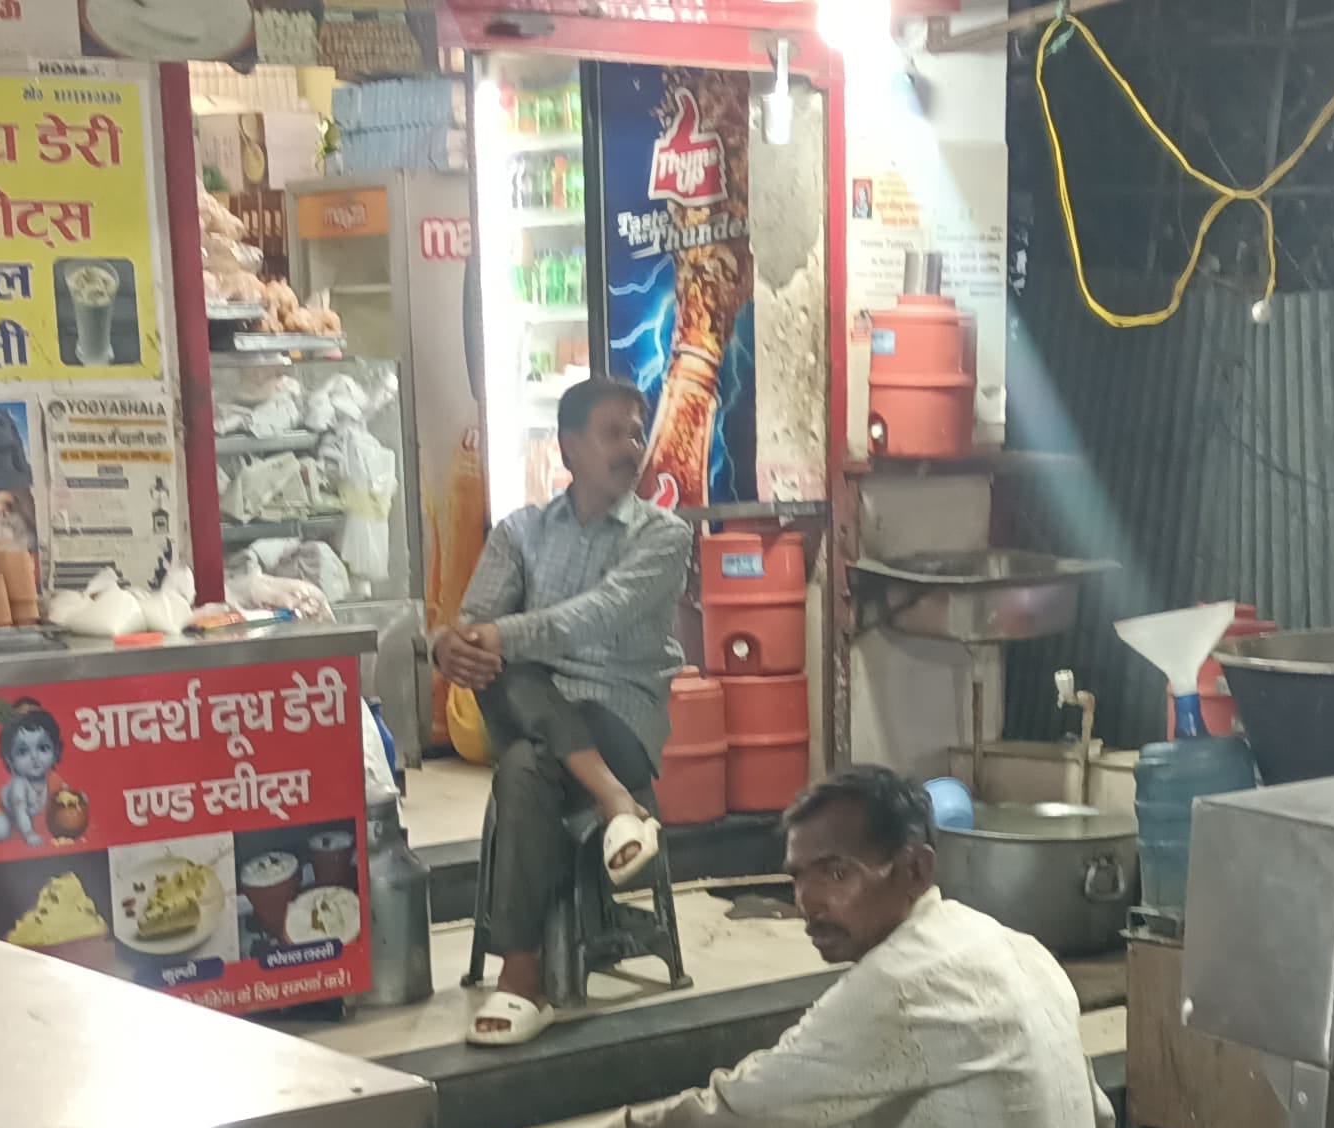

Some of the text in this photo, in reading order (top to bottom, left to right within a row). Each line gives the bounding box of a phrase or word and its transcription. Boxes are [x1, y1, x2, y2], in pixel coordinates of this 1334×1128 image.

[36, 111, 123, 168] डेरी
[66, 399, 167, 417] YOGYASHALA
[72, 665, 348, 758] आदर्श दूध डेरी
[122, 761, 312, 828] एण्ड स्वीट्स
